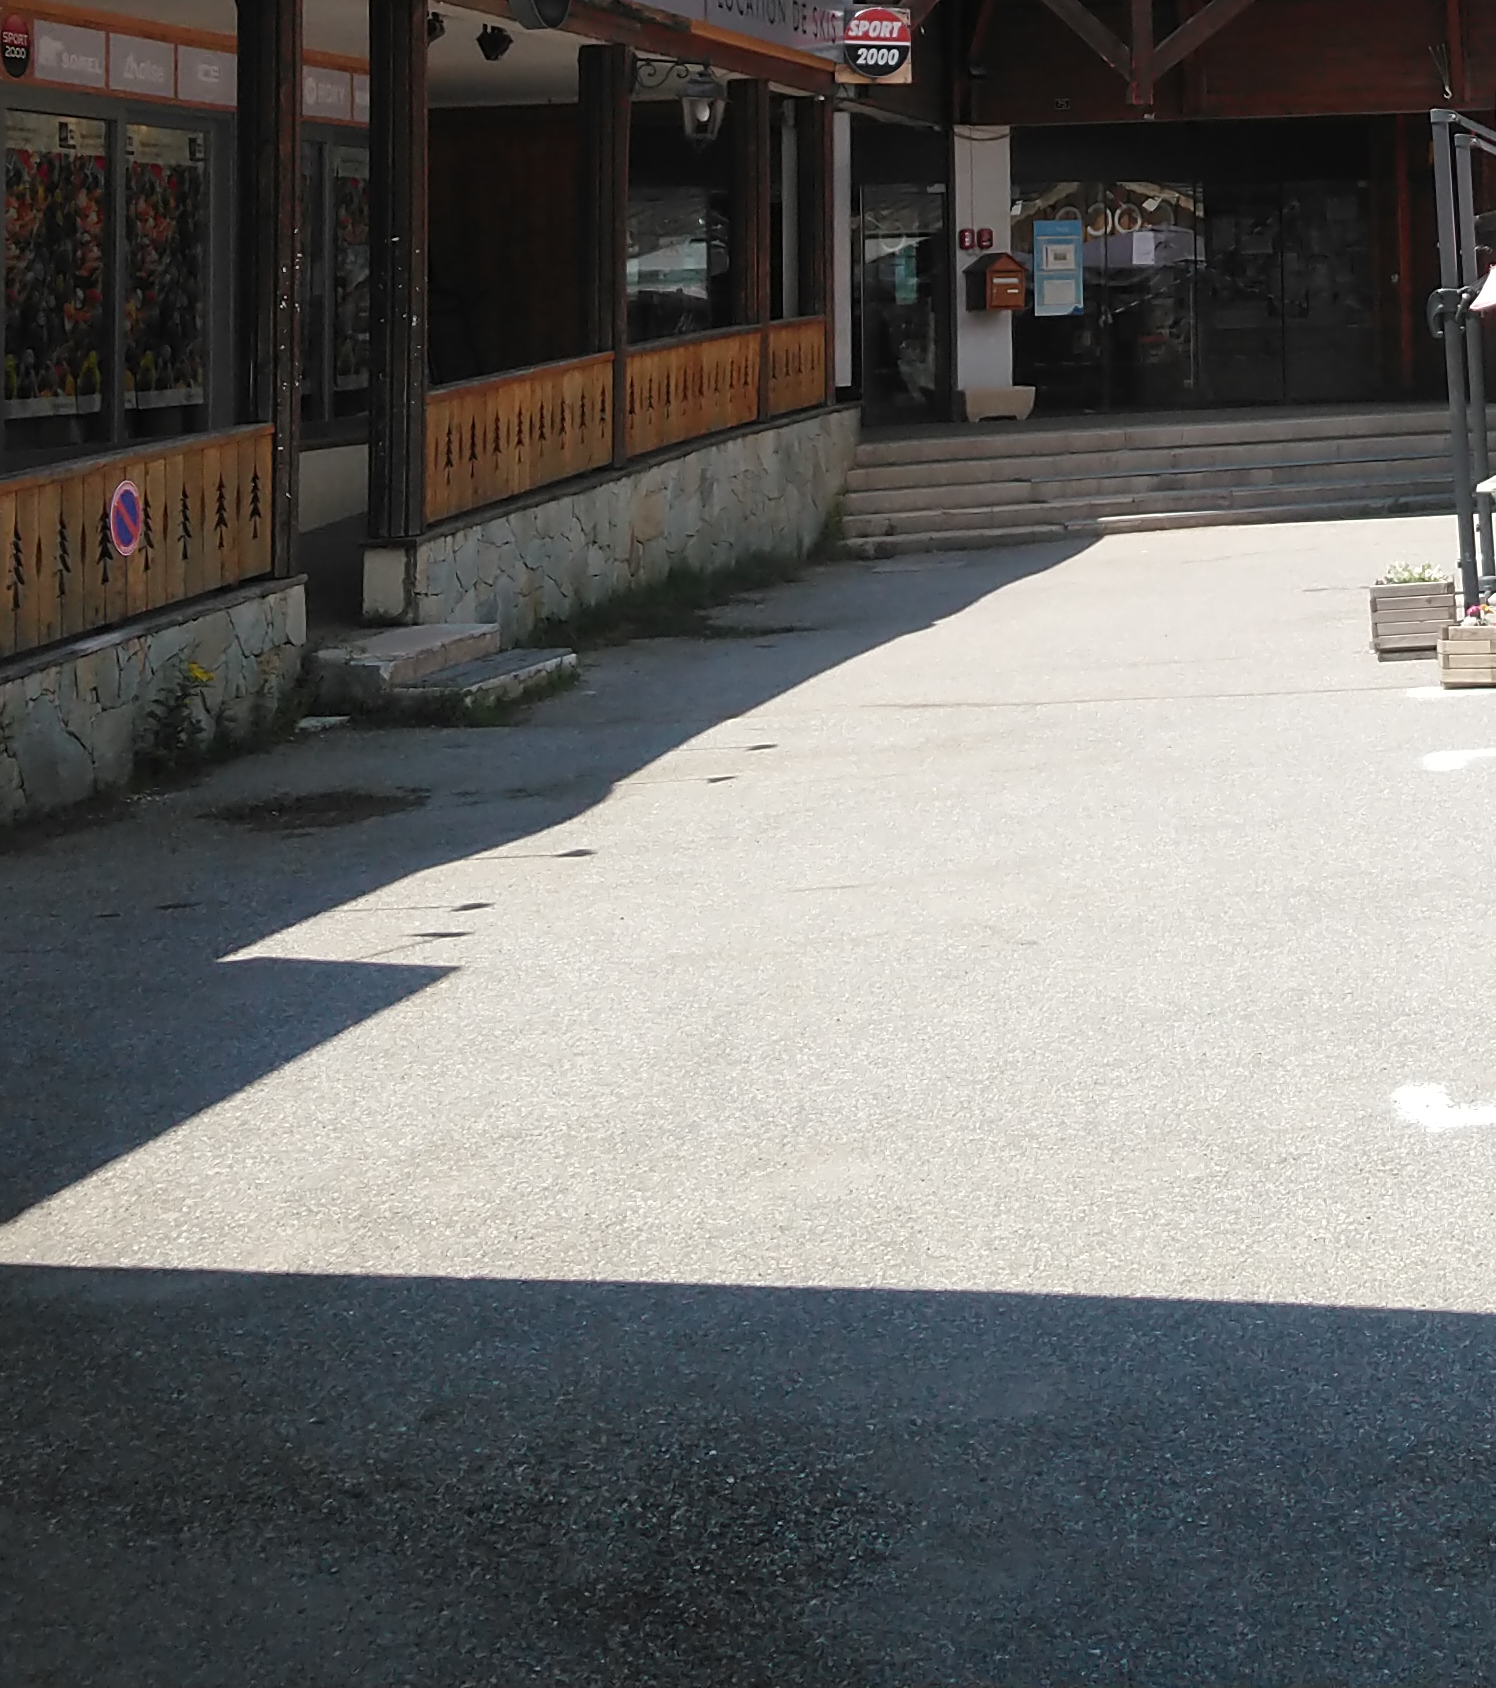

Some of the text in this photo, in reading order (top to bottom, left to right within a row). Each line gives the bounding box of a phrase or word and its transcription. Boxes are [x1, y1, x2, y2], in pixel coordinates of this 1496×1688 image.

[792, 0, 808, 36] DE
[812, 6, 837, 44] SKIS
[848, 19, 903, 39] SPORT
[2, 31, 29, 47] SPORT
[4, 45, 27, 59] 2000
[856, 47, 900, 66] 2000
